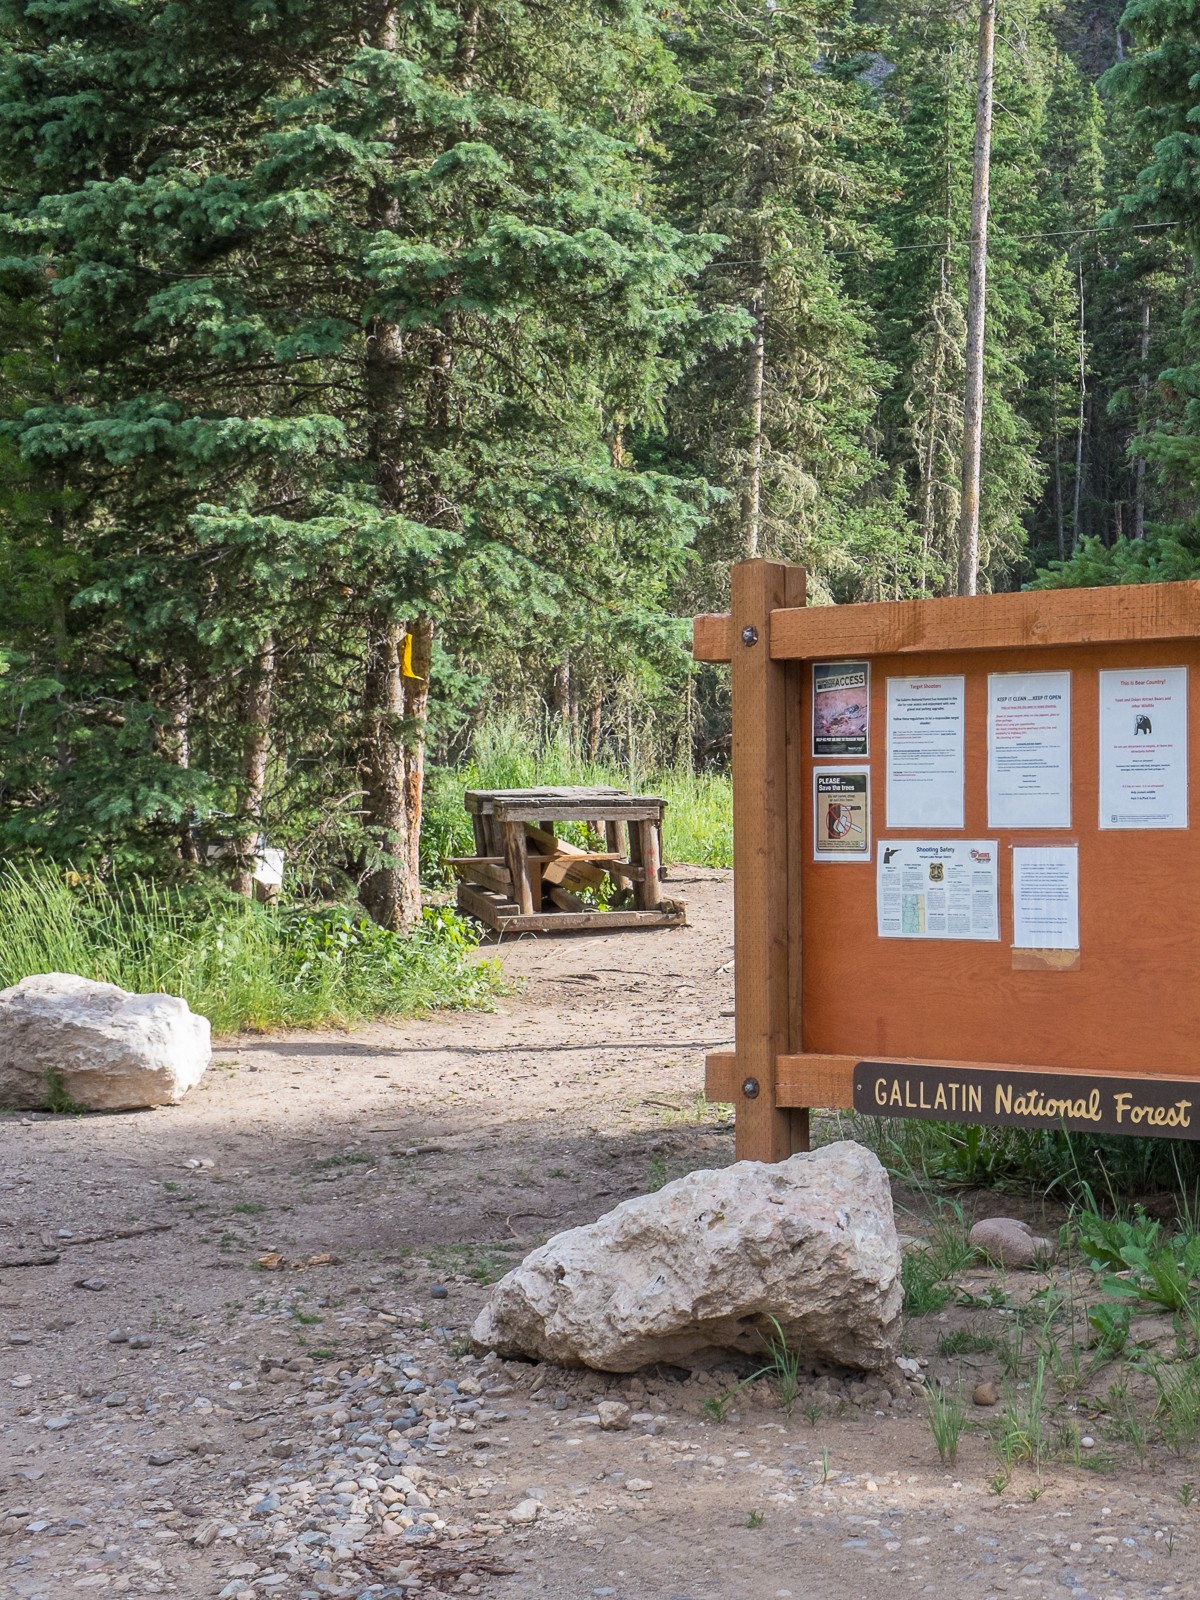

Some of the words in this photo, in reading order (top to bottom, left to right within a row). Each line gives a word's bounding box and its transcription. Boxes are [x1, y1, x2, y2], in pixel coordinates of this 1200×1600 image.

[835, 674, 864, 687] ACCESS
[916, 846, 938, 854] Shooting
[939, 846, 955, 854] Safety
[874, 1077, 982, 1114] GALLATIN
[994, 1083, 1102, 1122] National
[1112, 1091, 1193, 1128] Forest
